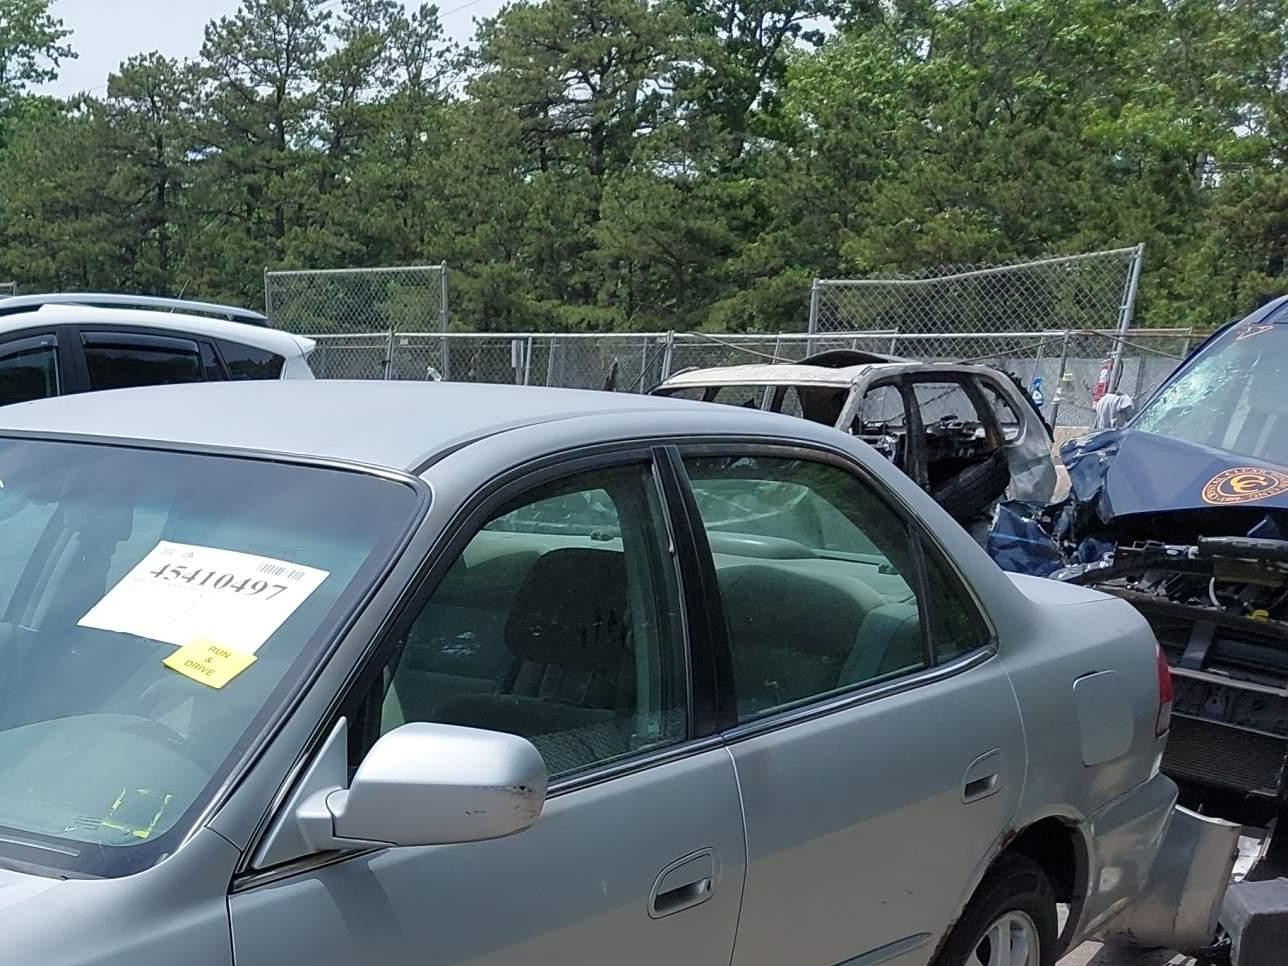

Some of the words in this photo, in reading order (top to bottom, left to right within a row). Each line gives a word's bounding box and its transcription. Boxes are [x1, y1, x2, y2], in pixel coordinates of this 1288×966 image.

[150, 563, 288, 600] 45410497
[204, 656, 215, 664] &
[207, 645, 232, 659] RUN
[183, 659, 216, 677] DRIVE
